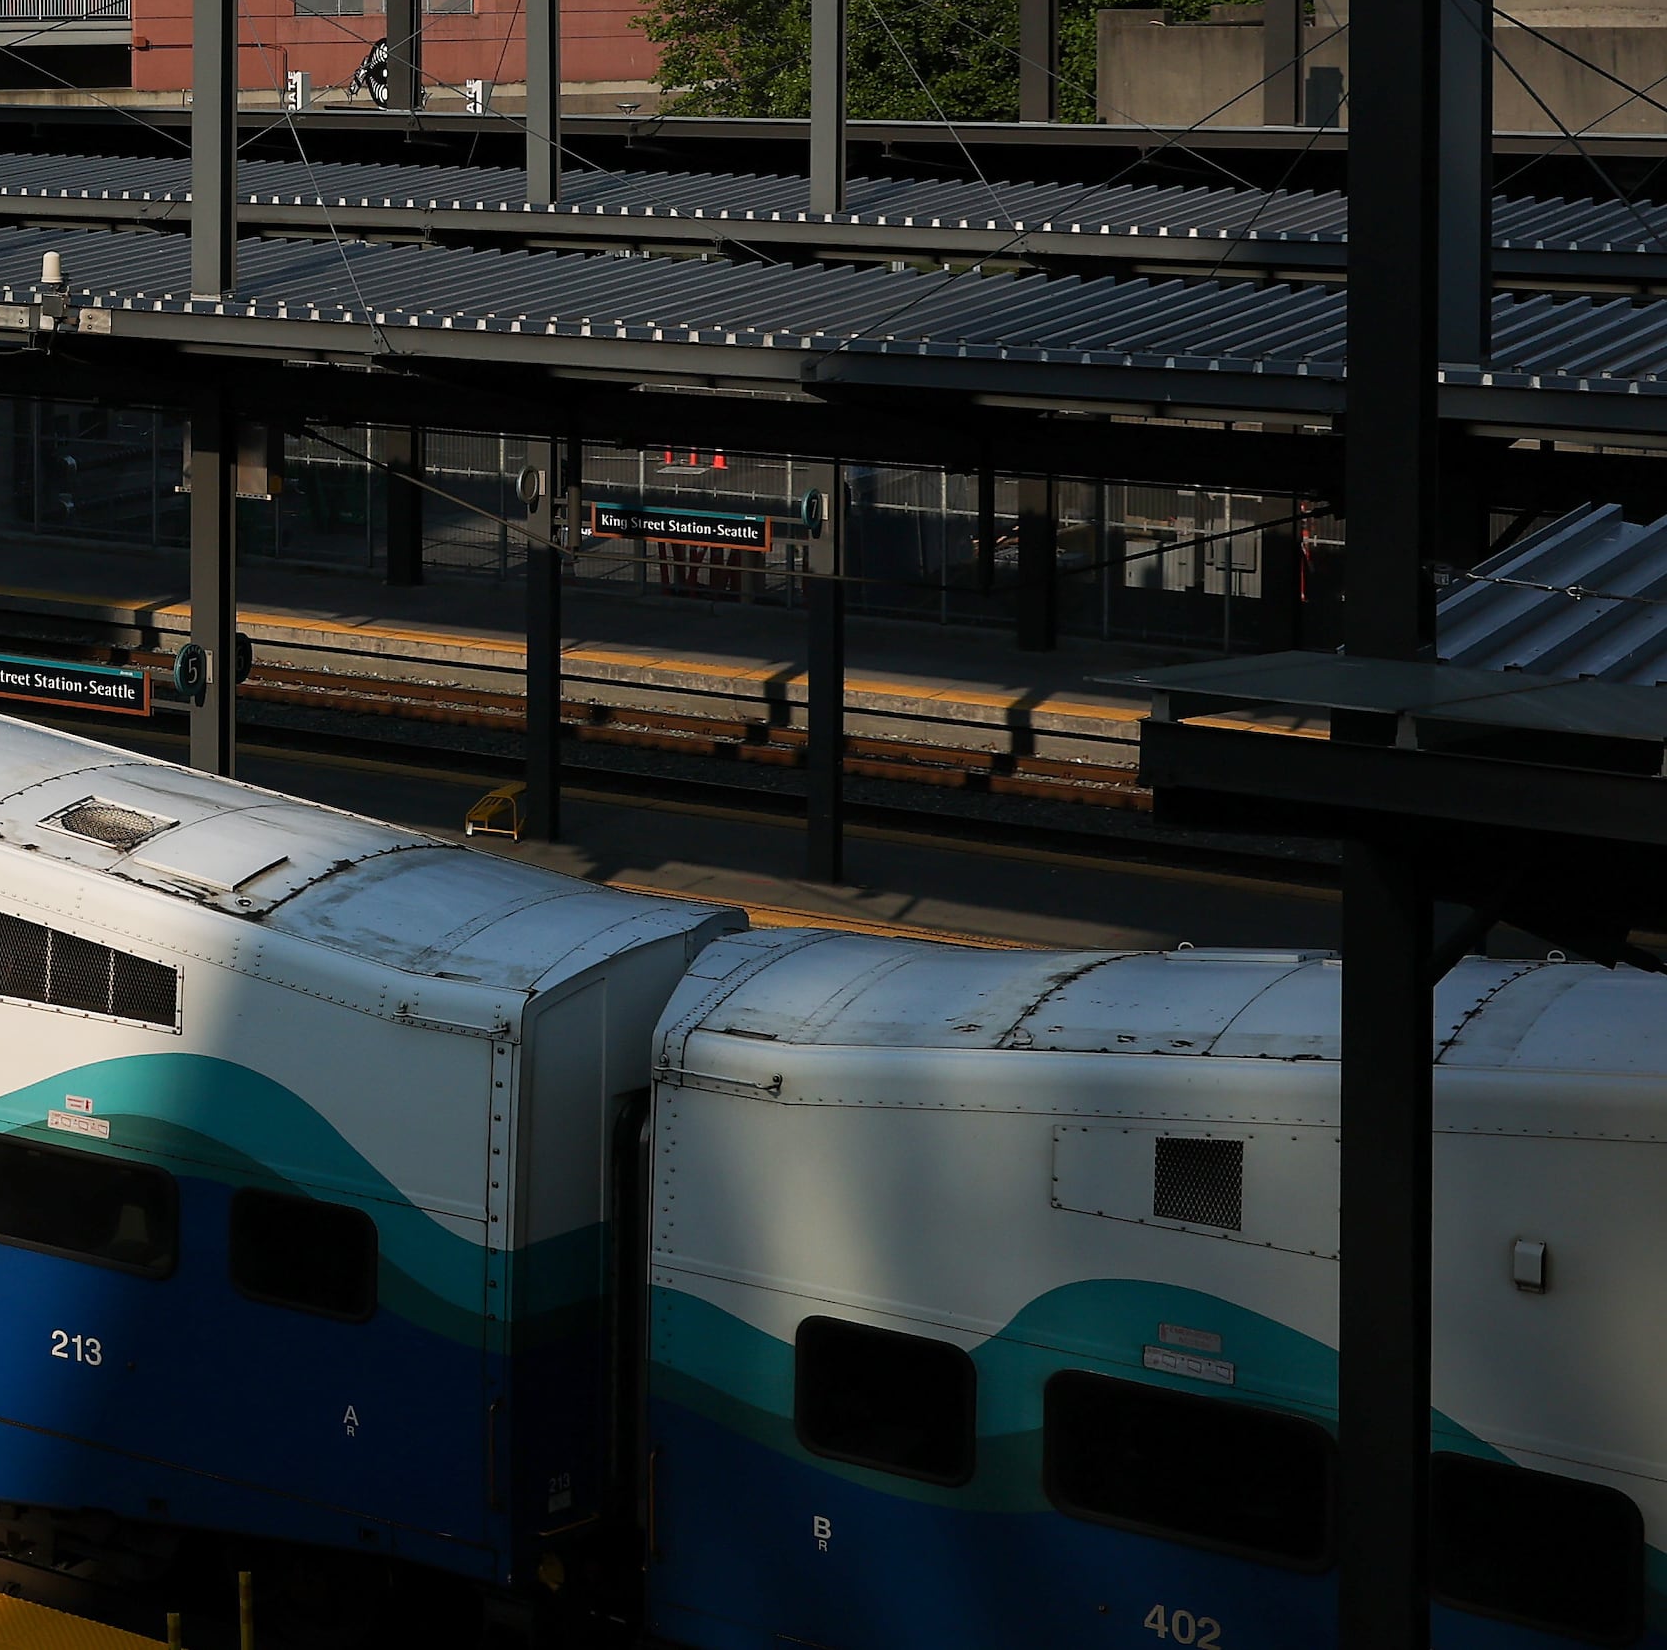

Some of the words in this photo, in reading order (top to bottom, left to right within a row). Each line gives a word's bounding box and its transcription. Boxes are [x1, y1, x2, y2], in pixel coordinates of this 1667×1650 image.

[810, 499, 818, 518] 7
[601, 513, 628, 531] King
[631, 516, 666, 532] Street
[187, 657, 198, 684] 5
[51, 1329, 104, 1368] 213
[343, 1405, 359, 1427] A
[346, 1425, 355, 1437] R
[547, 1471, 572, 1493] 213
[812, 1515, 832, 1540] B
[818, 1539, 828, 1552] R
[1143, 1603, 1223, 1650] 402
